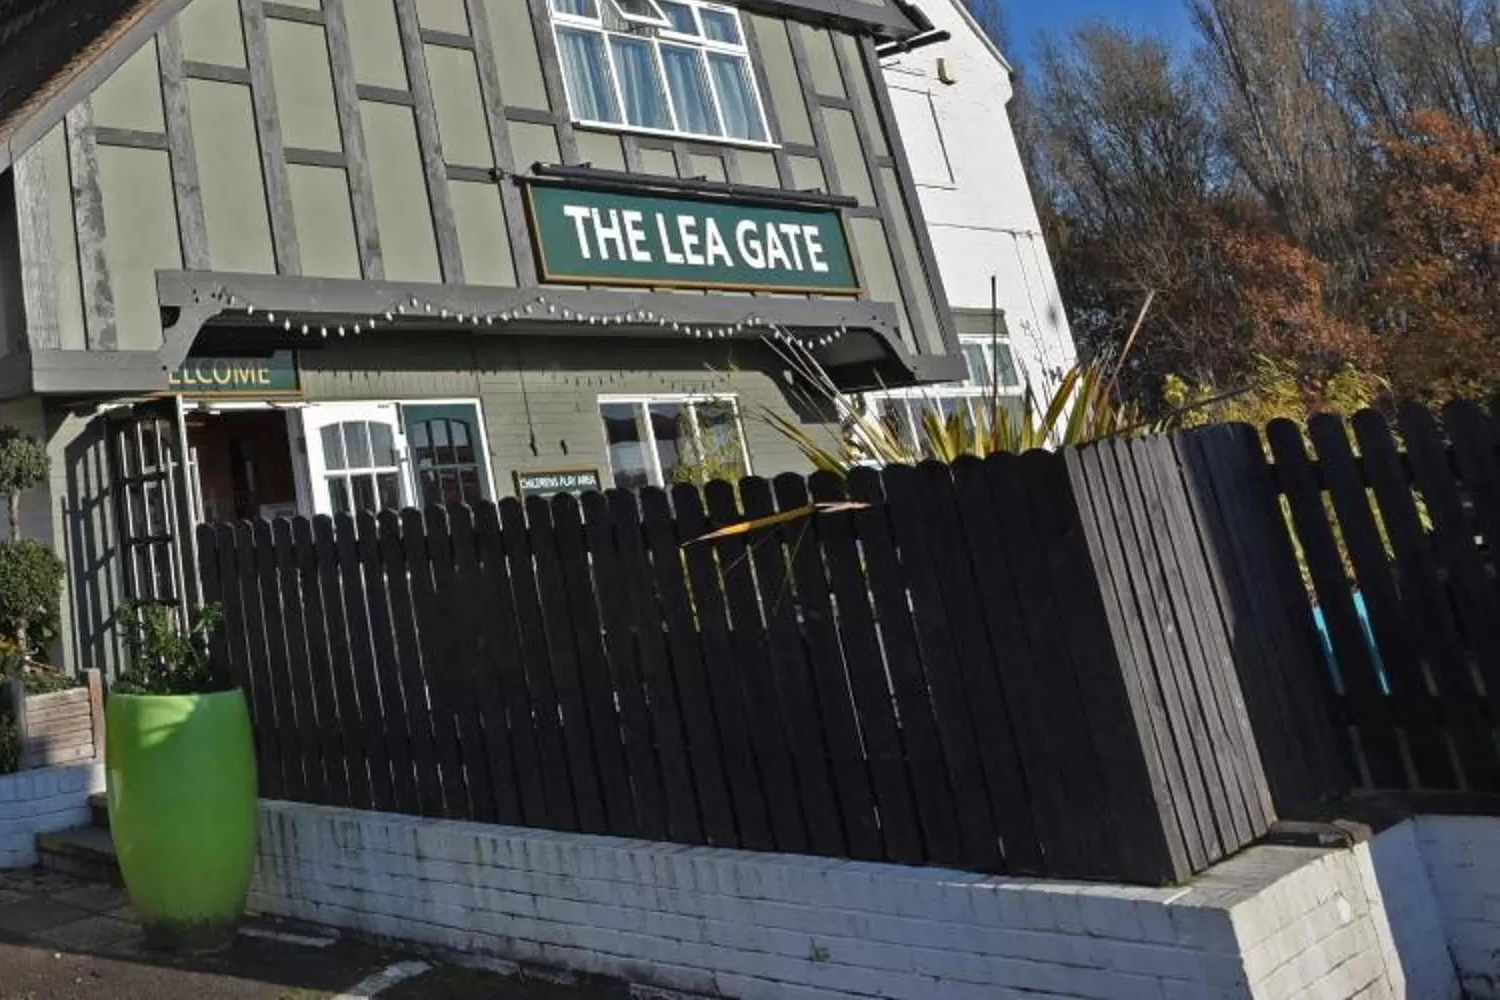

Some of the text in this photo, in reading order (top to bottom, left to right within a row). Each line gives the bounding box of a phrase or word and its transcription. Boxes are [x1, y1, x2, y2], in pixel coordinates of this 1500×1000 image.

[563, 205, 829, 272] THE LEA GATE
[168, 361, 271, 385] ELCOME
